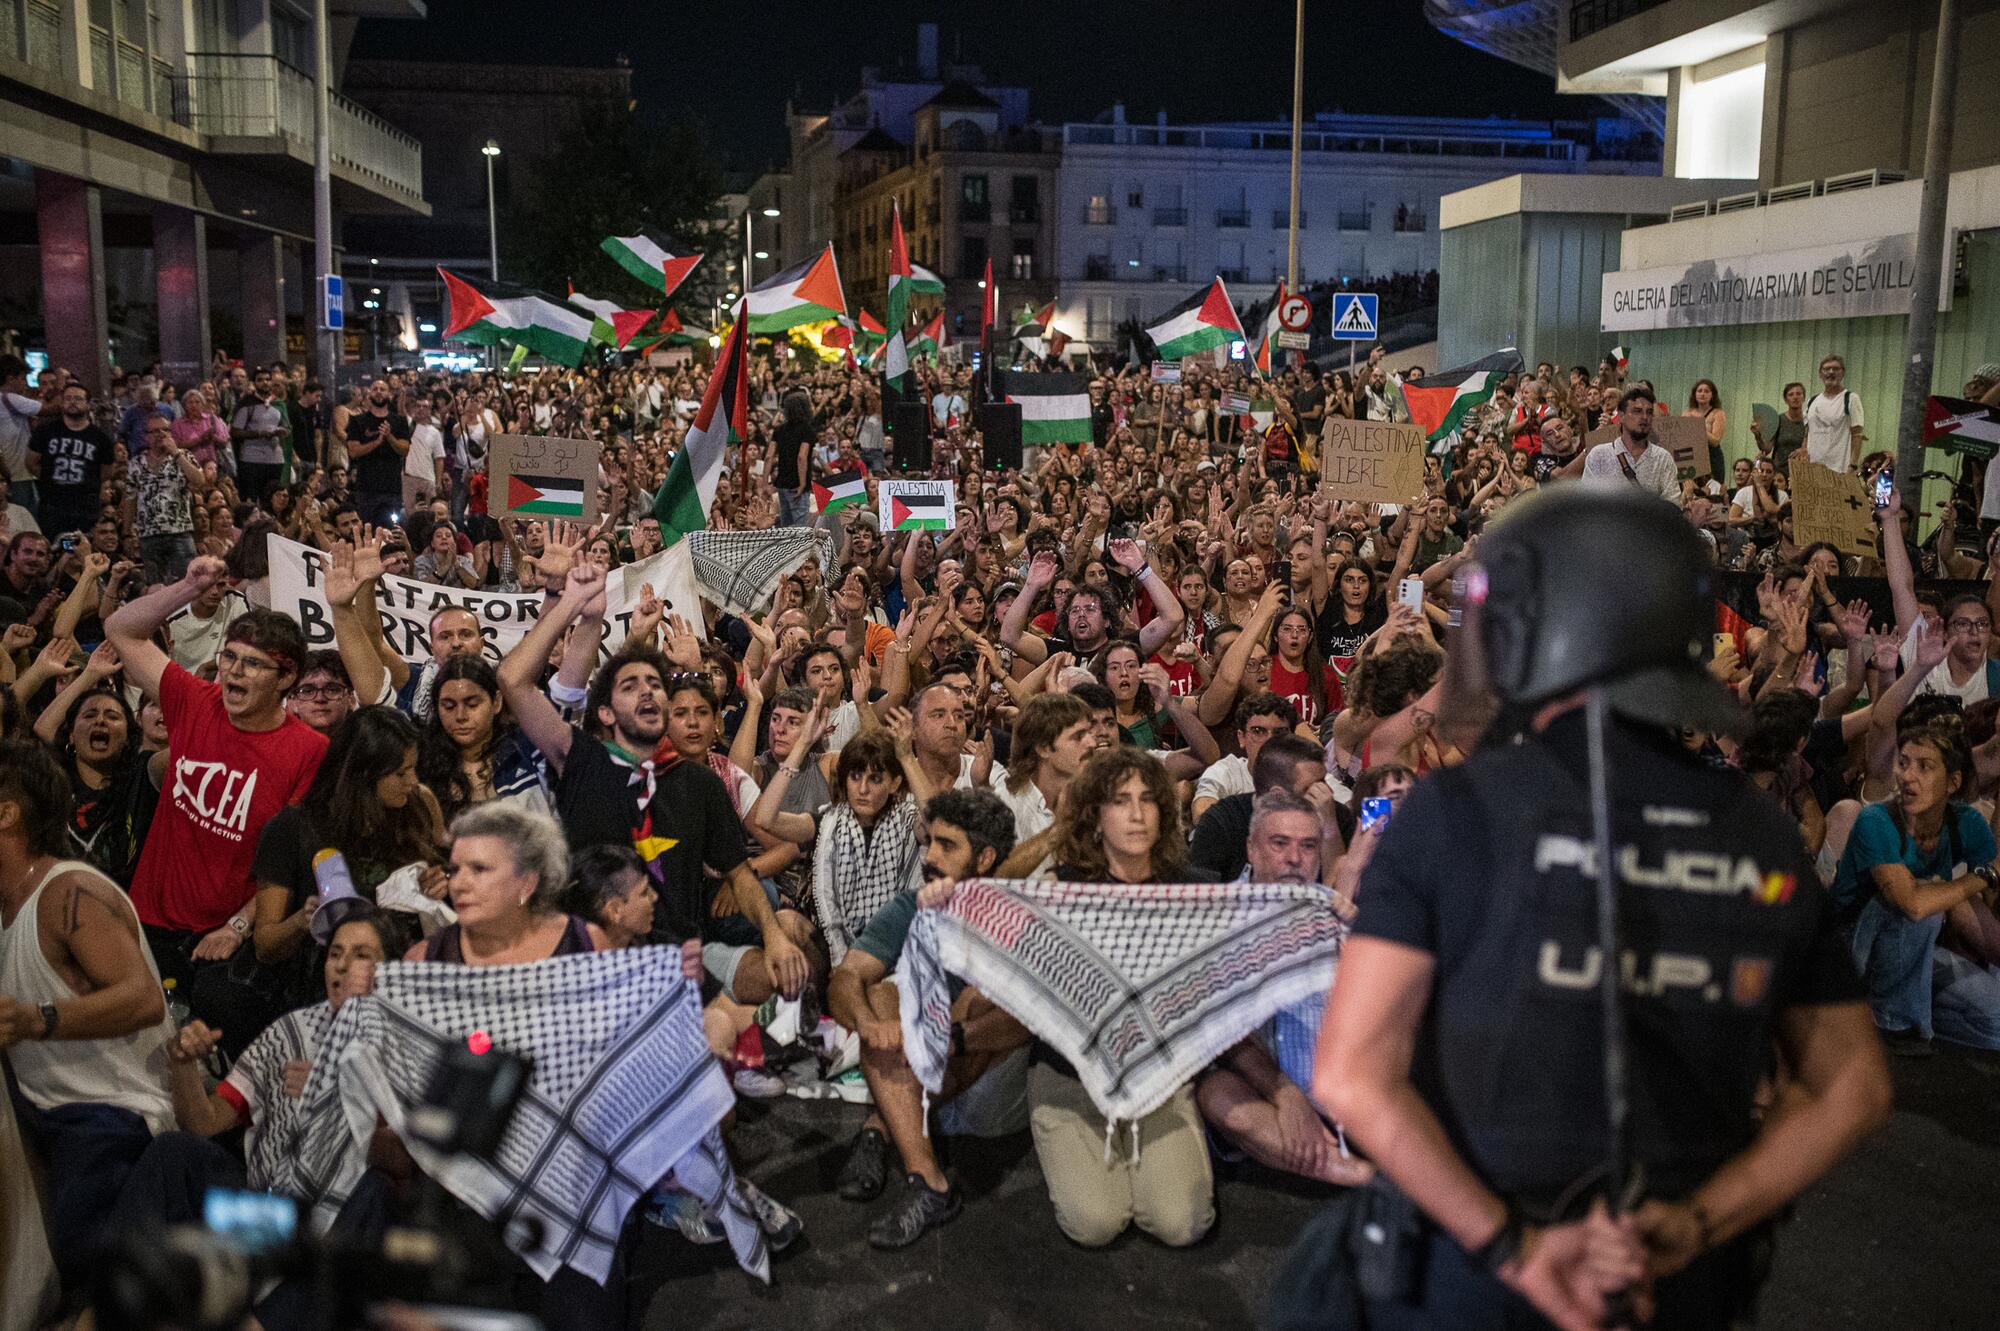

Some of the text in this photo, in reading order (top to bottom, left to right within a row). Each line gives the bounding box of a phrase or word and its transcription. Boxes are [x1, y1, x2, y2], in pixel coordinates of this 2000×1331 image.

[1613, 285, 1667, 313] GALERIA
[1669, 283, 1696, 308] DEL
[1812, 268, 1838, 296] DE
[48, 438, 97, 461] SFDK
[1331, 423, 1422, 457] PALESTINA
[52, 457, 85, 484] 25
[1325, 456, 1389, 489] LIBRE
[888, 481, 946, 496] PALESTINA
[882, 497, 890, 531] VIVA
[199, 819, 212, 831] EN
[211, 826, 243, 842] ACTIVO
